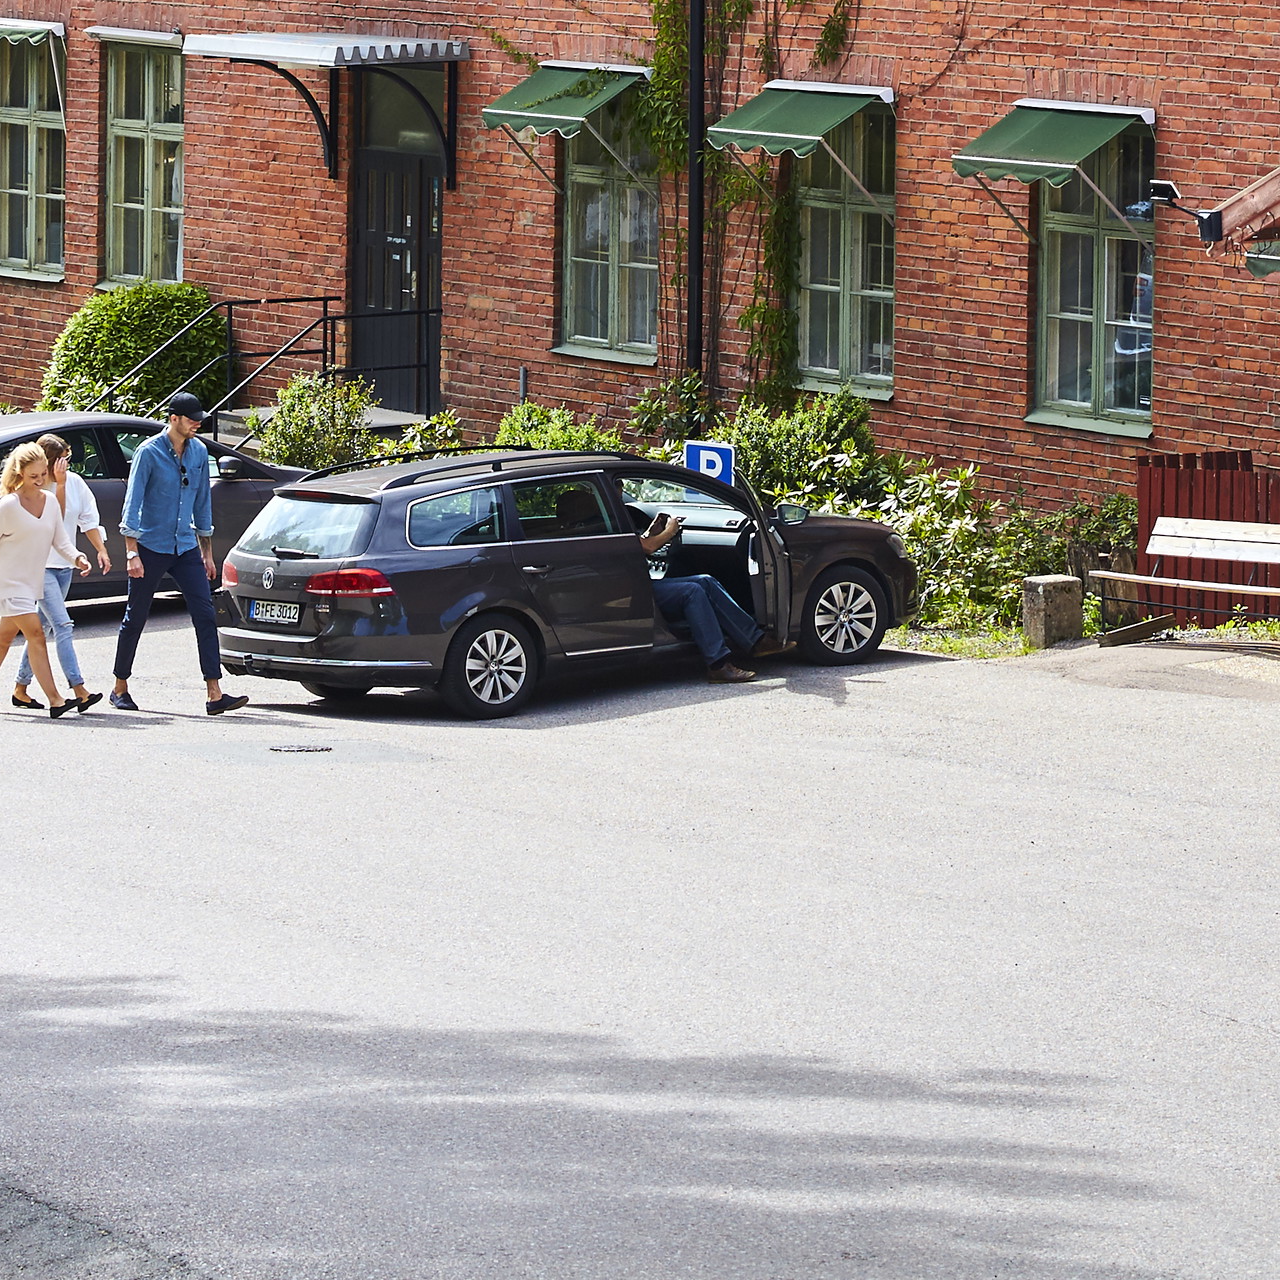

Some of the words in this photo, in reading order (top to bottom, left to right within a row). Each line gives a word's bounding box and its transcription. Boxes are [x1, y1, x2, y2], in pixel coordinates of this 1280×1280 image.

[254, 602, 262, 616] B
[265, 604, 275, 618] FE
[276, 606, 299, 620] 3012
